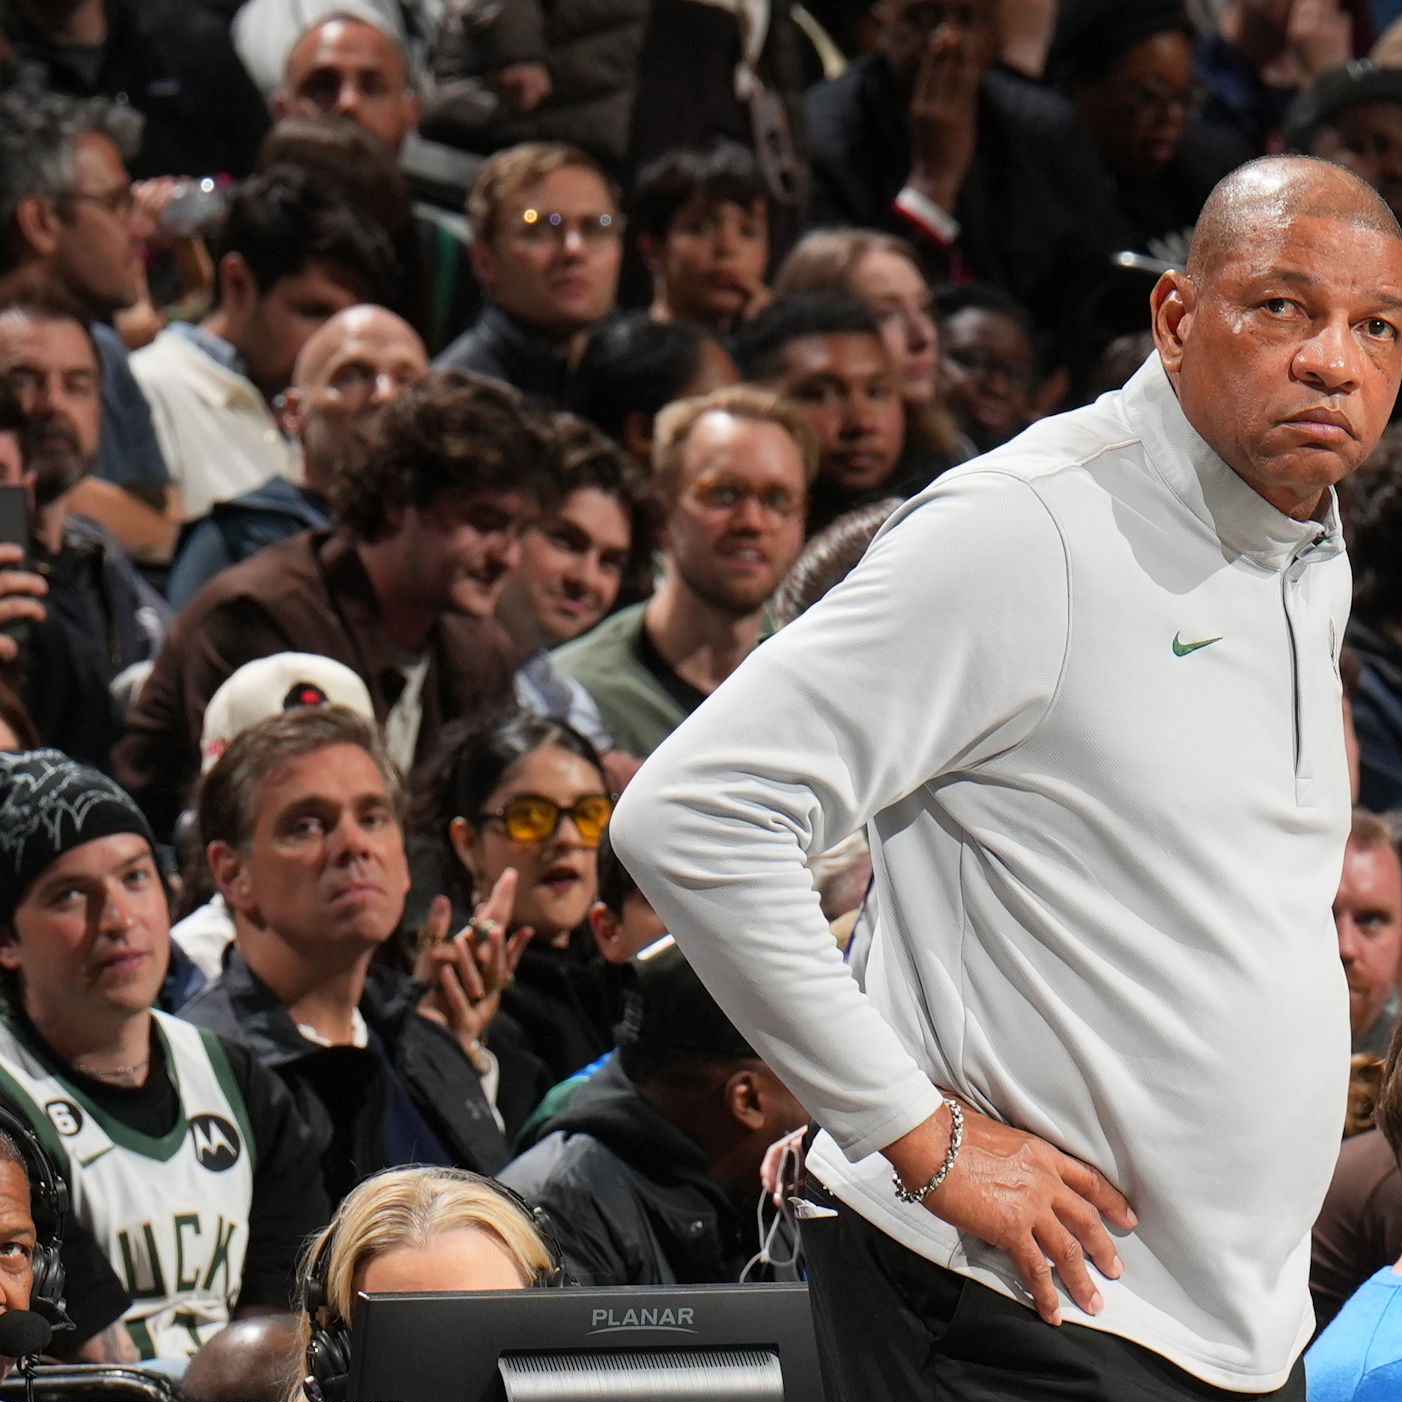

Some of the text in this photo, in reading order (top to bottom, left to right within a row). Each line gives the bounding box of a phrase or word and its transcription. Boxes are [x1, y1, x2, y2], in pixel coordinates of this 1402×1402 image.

[47, 1103, 78, 1137] 6
[117, 1212, 241, 1302] UCK
[591, 1307, 695, 1327] PLANAR
